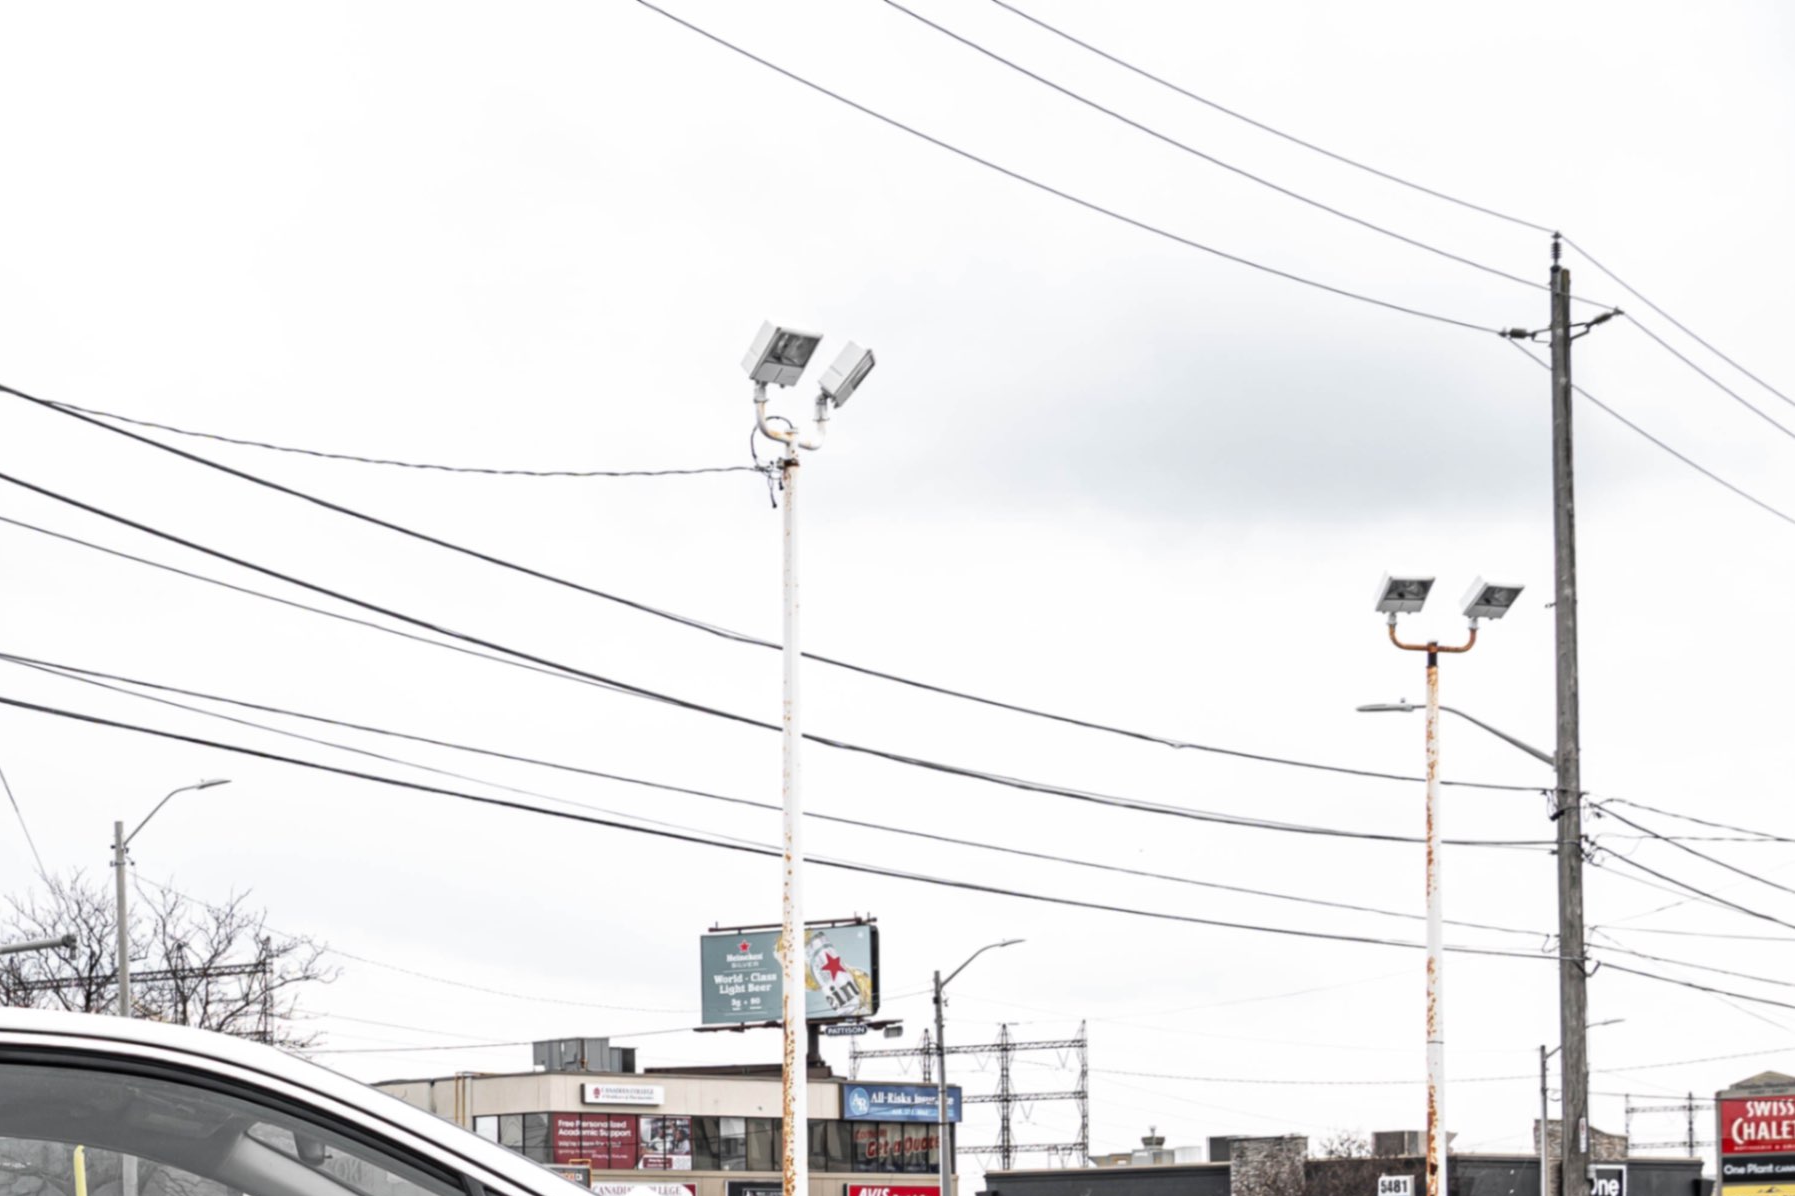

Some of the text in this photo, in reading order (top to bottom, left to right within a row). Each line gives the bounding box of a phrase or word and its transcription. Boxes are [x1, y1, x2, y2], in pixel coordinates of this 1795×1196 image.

[714, 973, 743, 984] World
[751, 972, 777, 982] Class
[719, 983, 772, 995] Light Beer
[870, 1091, 911, 1105] All-Risks
[1746, 1098, 1795, 1118] SWISS
[1724, 1164, 1746, 1175] One
[1747, 1163, 1773, 1174] Plant
[1380, 1179, 1408, 1194] 5481
